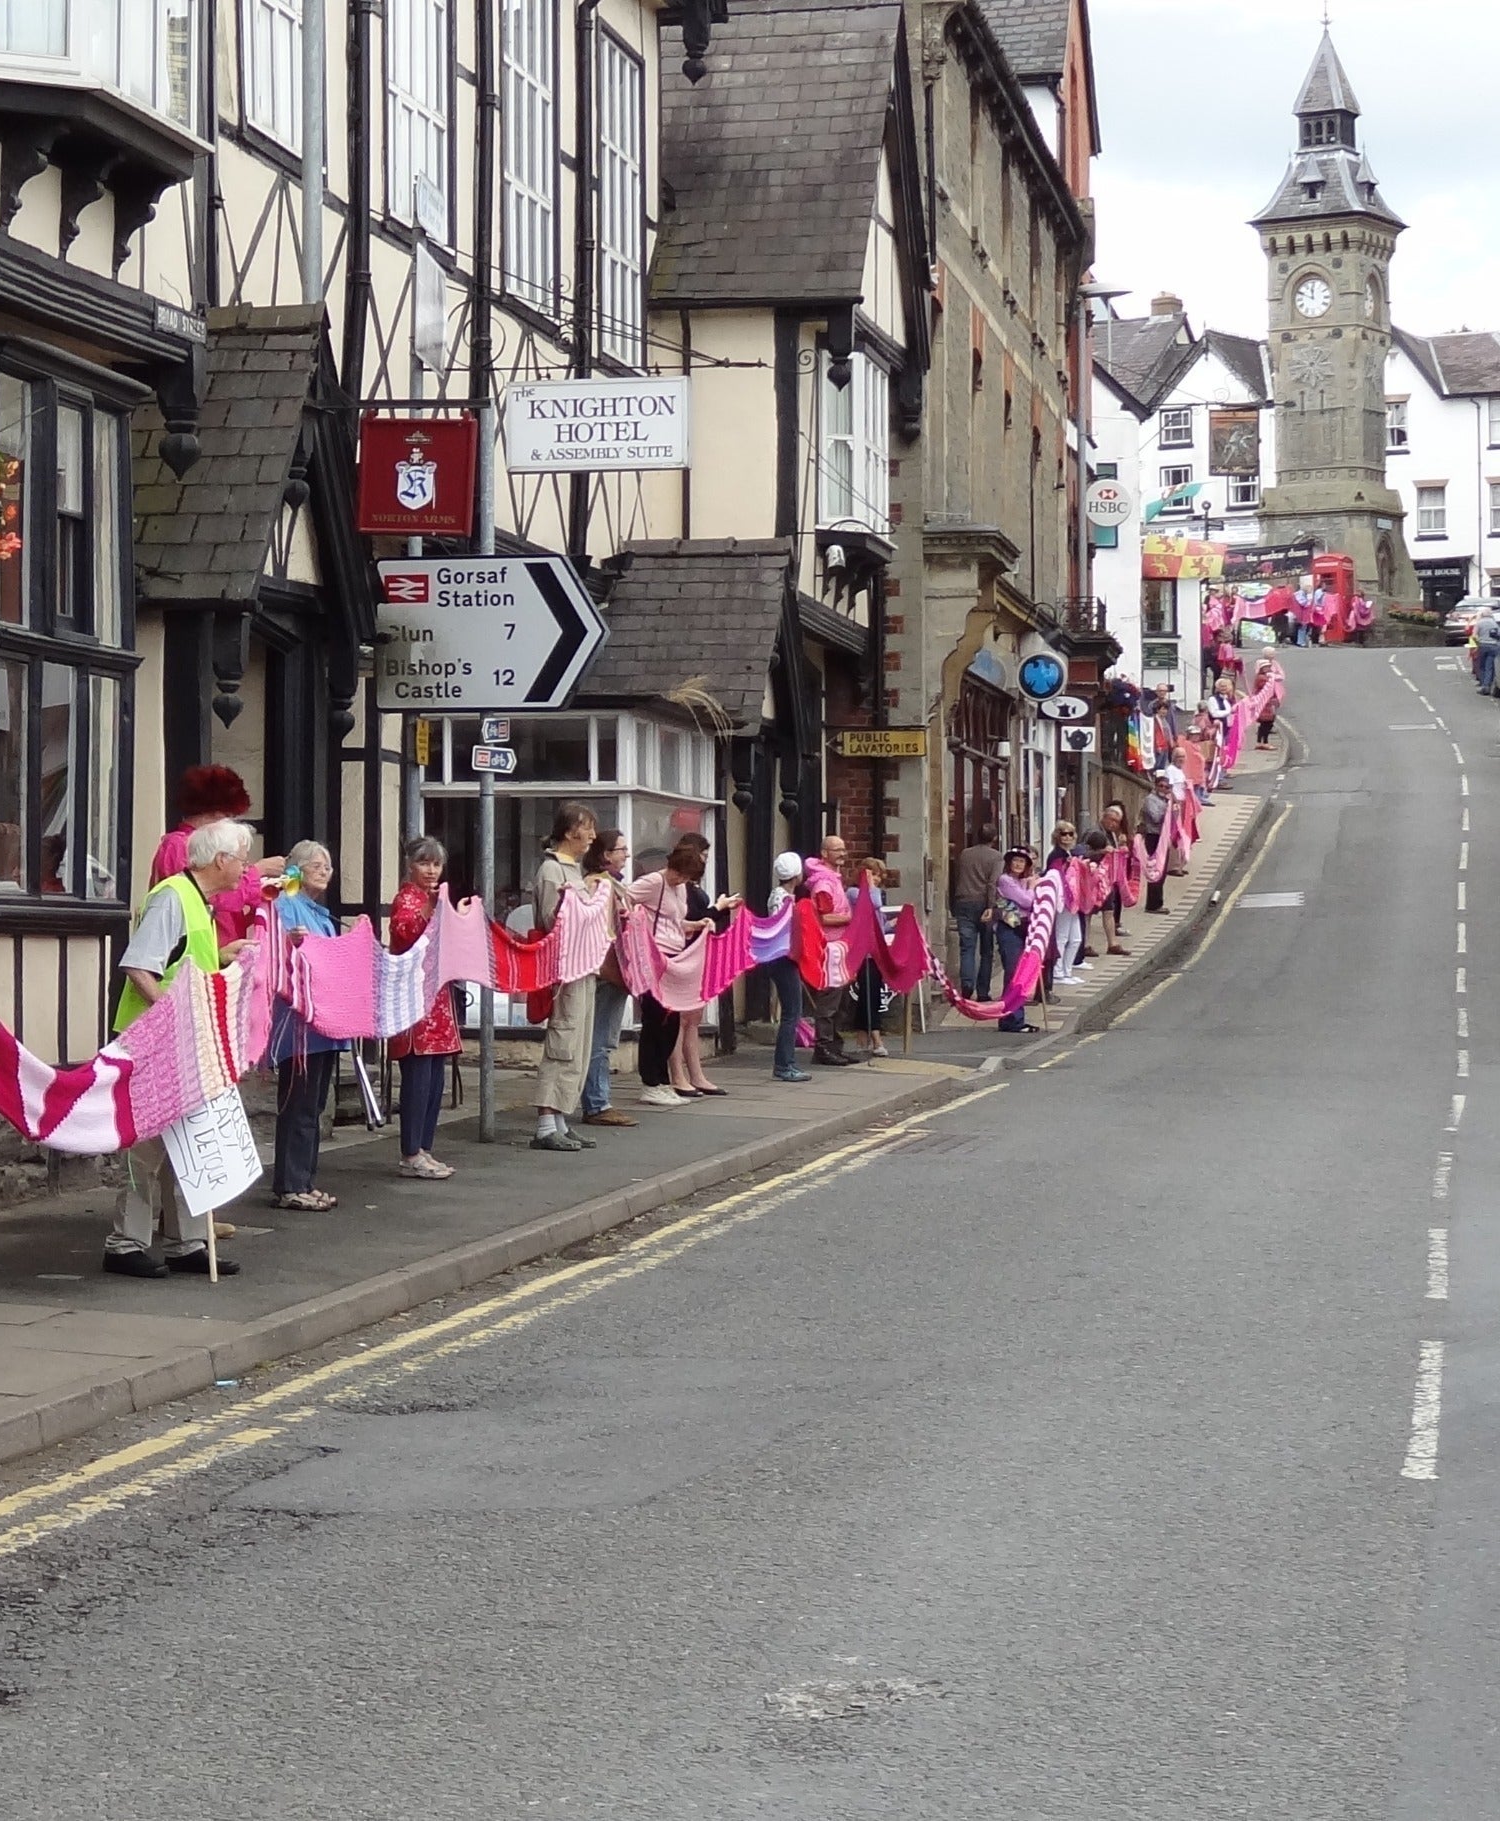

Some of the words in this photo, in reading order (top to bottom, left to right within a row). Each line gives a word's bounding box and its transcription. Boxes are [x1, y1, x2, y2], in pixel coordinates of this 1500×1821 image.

[157, 306, 178, 328] BROAD
[512, 386, 535, 402] The
[527, 395, 677, 419] KNIGHTON
[553, 421, 649, 443] HOTEL
[530, 449, 543, 461] &
[545, 447, 624, 461] ASSEMBLY
[627, 445, 673, 459] SUITE
[1088, 501, 1128, 514] HSBC
[372, 514, 419, 523] NORTON
[421, 514, 456, 524] ARMS
[436, 566, 508, 585] Gorsaf
[436, 590, 515, 608] Station
[504, 623, 516, 640] 7
[386, 658, 473, 676] Bishop's
[493, 669, 515, 686] 12
[395, 682, 462, 699] Castle
[849, 733, 891, 742] PUBLIC
[849, 743, 919, 754] LAVATORIES
[194, 1127, 228, 1190] DETOUR
